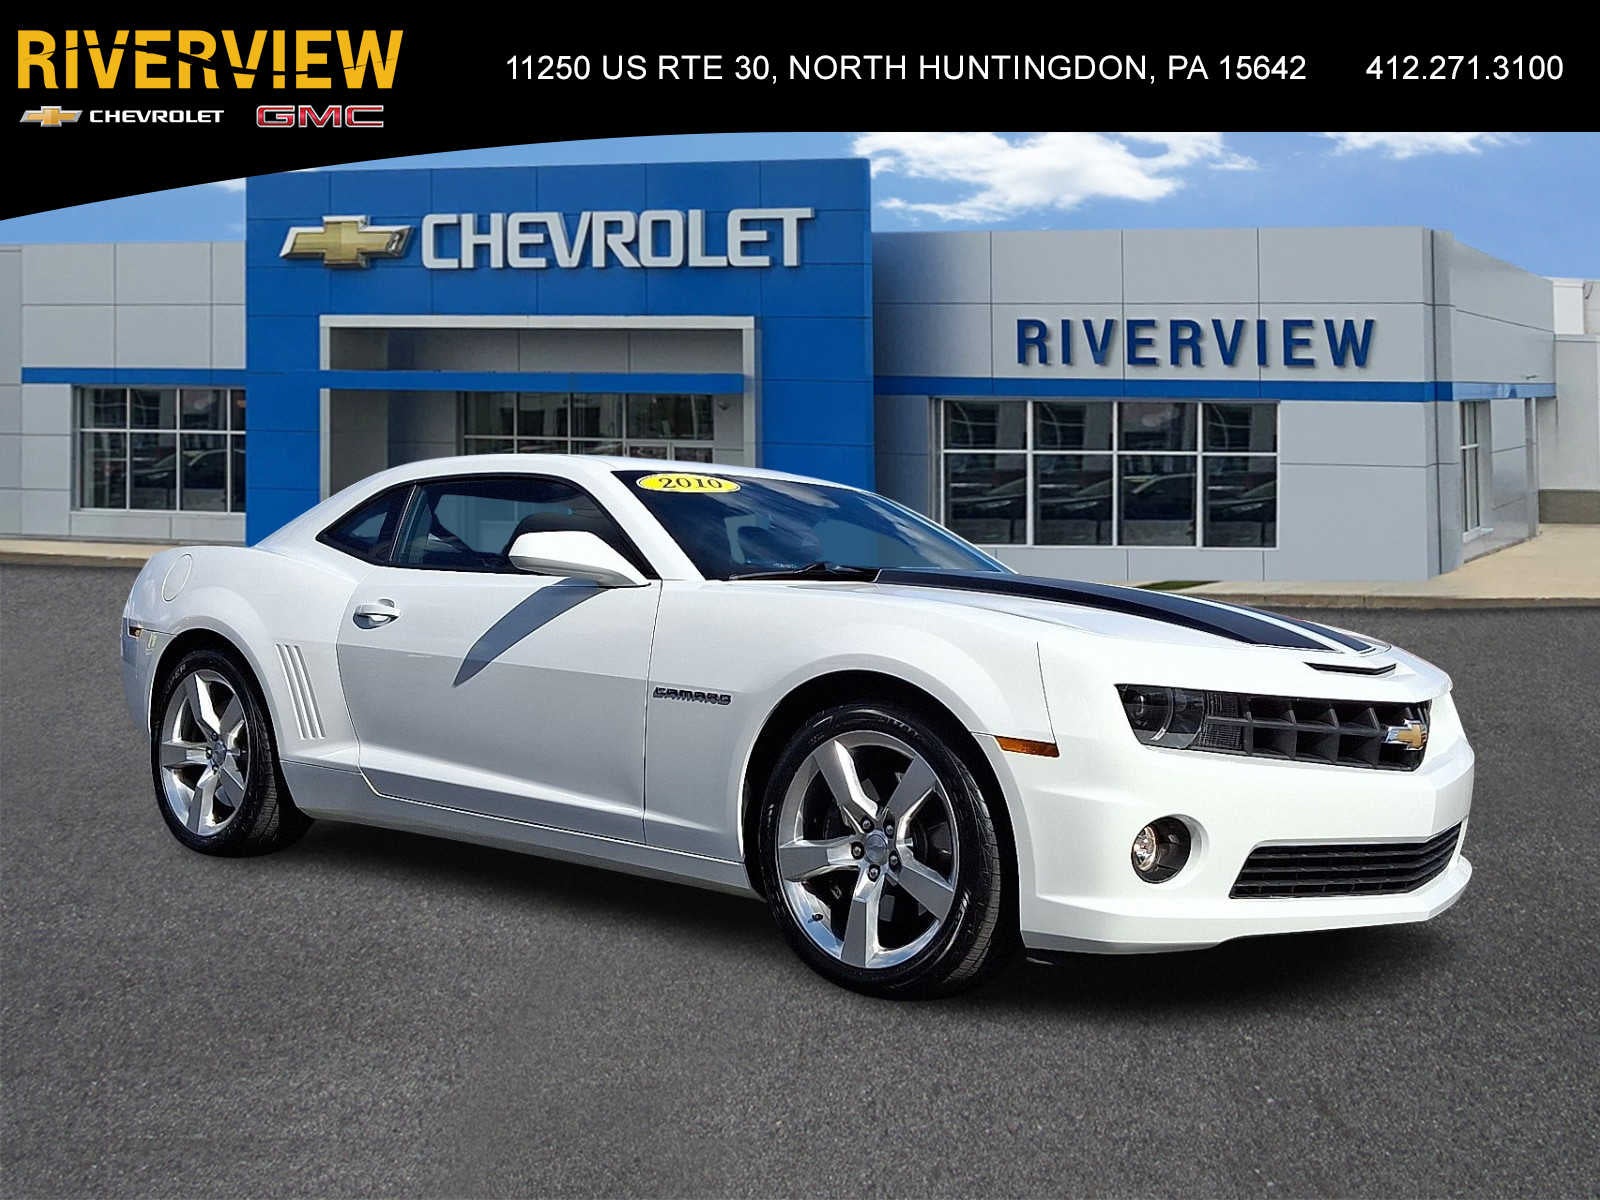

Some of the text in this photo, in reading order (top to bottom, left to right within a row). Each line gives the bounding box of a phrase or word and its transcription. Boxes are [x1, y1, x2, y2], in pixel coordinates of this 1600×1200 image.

[421, 207, 813, 270] CHEVROLET
[1016, 316, 1376, 368] RIVERVIEW
[658, 477, 723, 489] 2010
[652, 686, 732, 706] CAMARO
